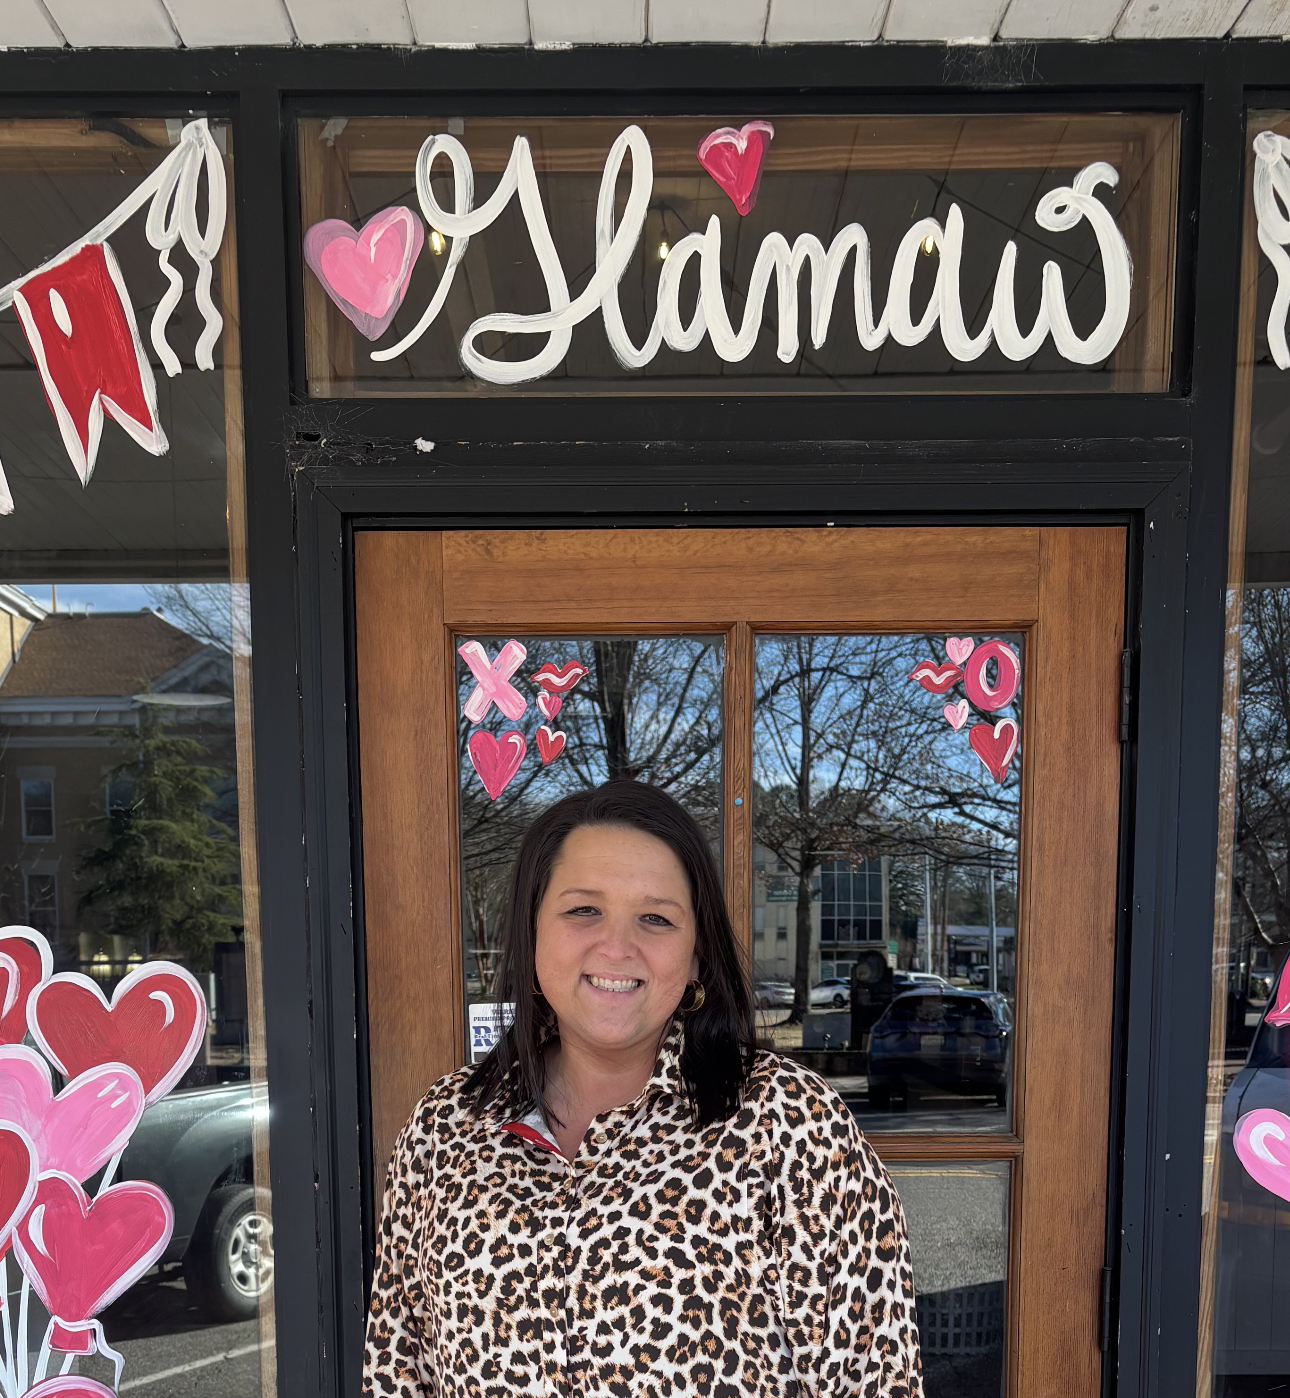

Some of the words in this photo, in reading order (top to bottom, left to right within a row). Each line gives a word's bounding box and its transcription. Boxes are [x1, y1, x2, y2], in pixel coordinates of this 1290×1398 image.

[370, 124, 1134, 385] Glamaw
[457, 639, 528, 724] X
[964, 640, 1020, 711] O
